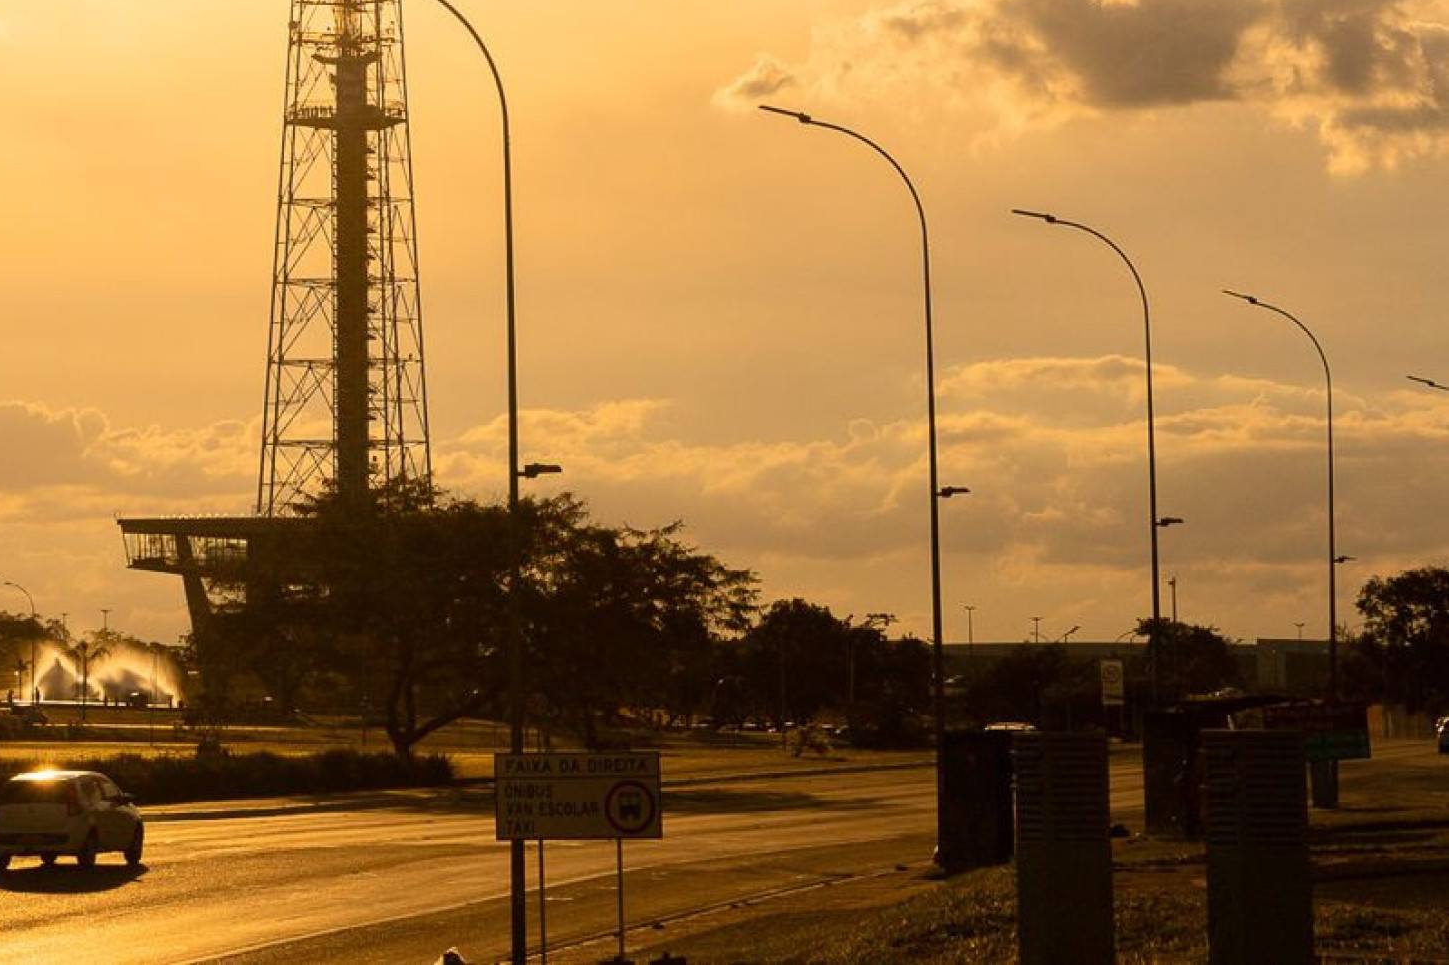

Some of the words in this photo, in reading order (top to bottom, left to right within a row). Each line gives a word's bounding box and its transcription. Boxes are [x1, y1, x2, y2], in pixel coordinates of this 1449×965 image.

[505, 758, 550, 773] FAIXA
[559, 758, 580, 773] DA
[587, 758, 648, 773] DIREITA
[506, 802, 533, 816] VAN
[538, 802, 598, 816] ESCOLAR
